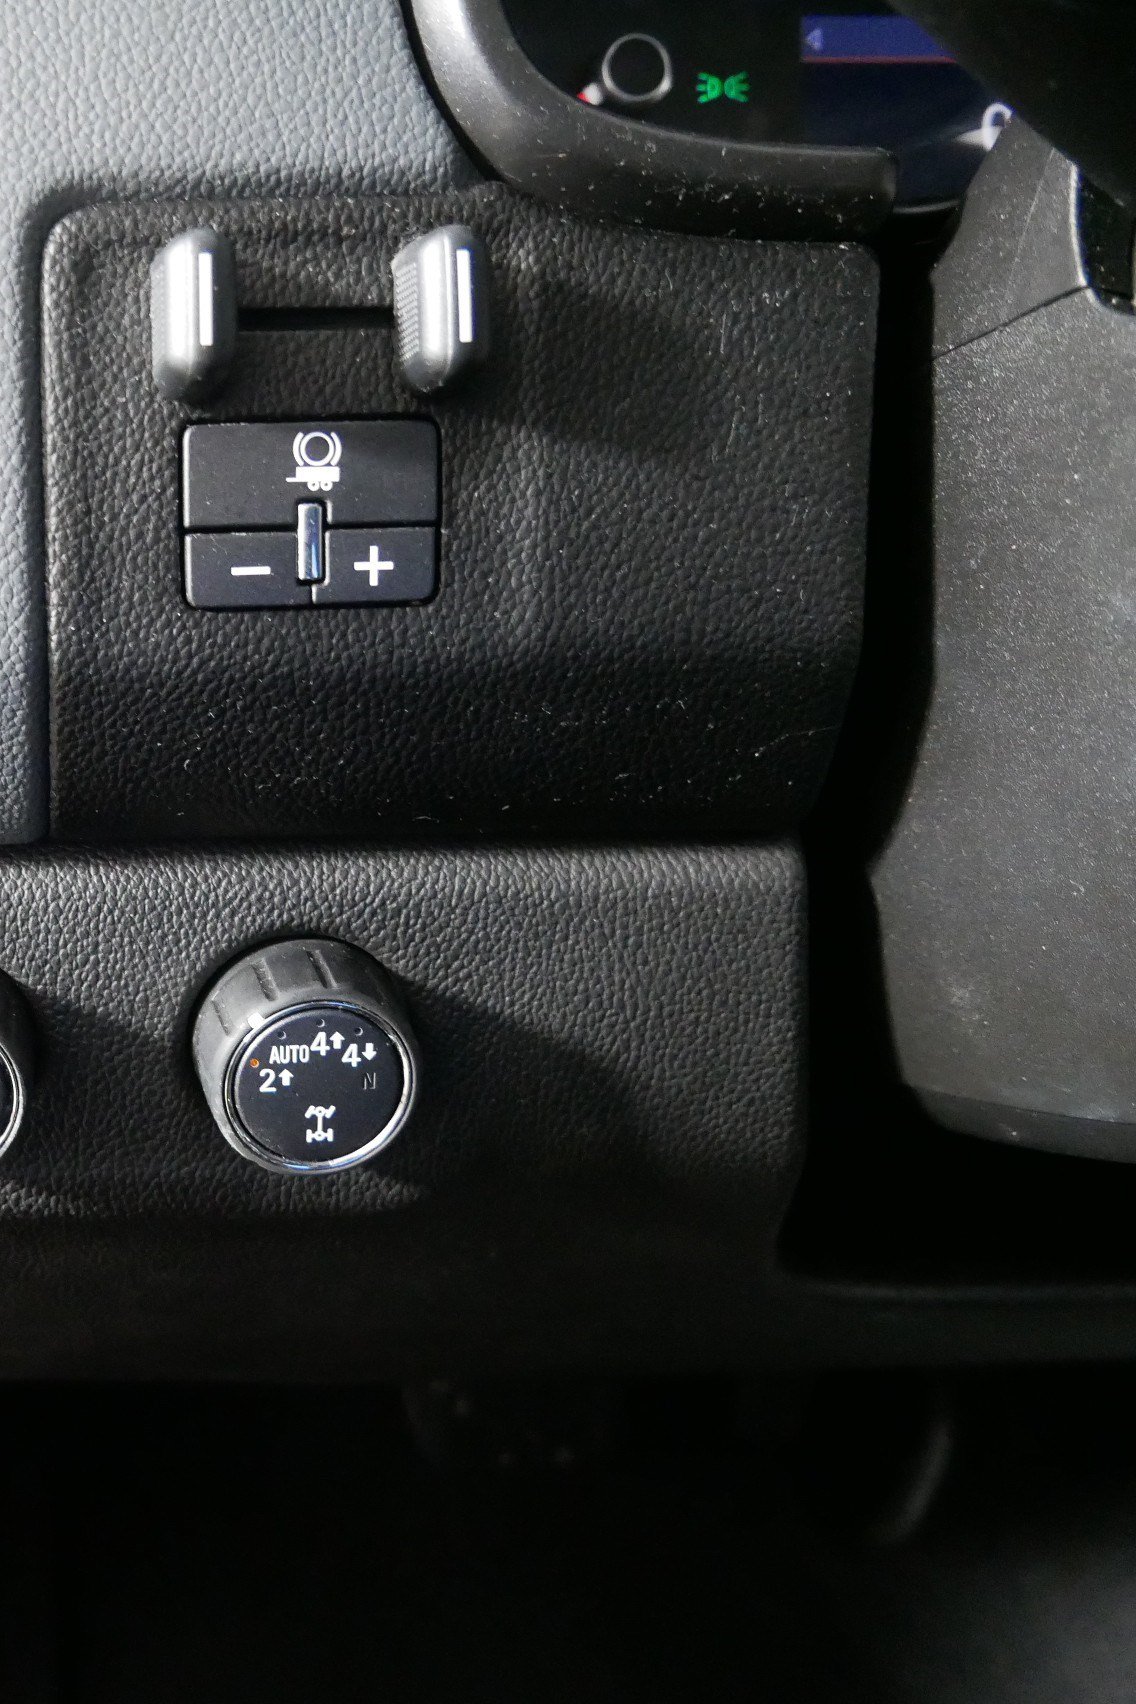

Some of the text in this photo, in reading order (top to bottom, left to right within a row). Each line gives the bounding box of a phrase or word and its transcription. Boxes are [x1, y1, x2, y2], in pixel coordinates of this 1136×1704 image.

[269, 1044, 310, 1064] AUTO
[310, 1031, 330, 1057] 4
[341, 1043, 362, 1068] 4
[259, 1068, 277, 1093] 2
